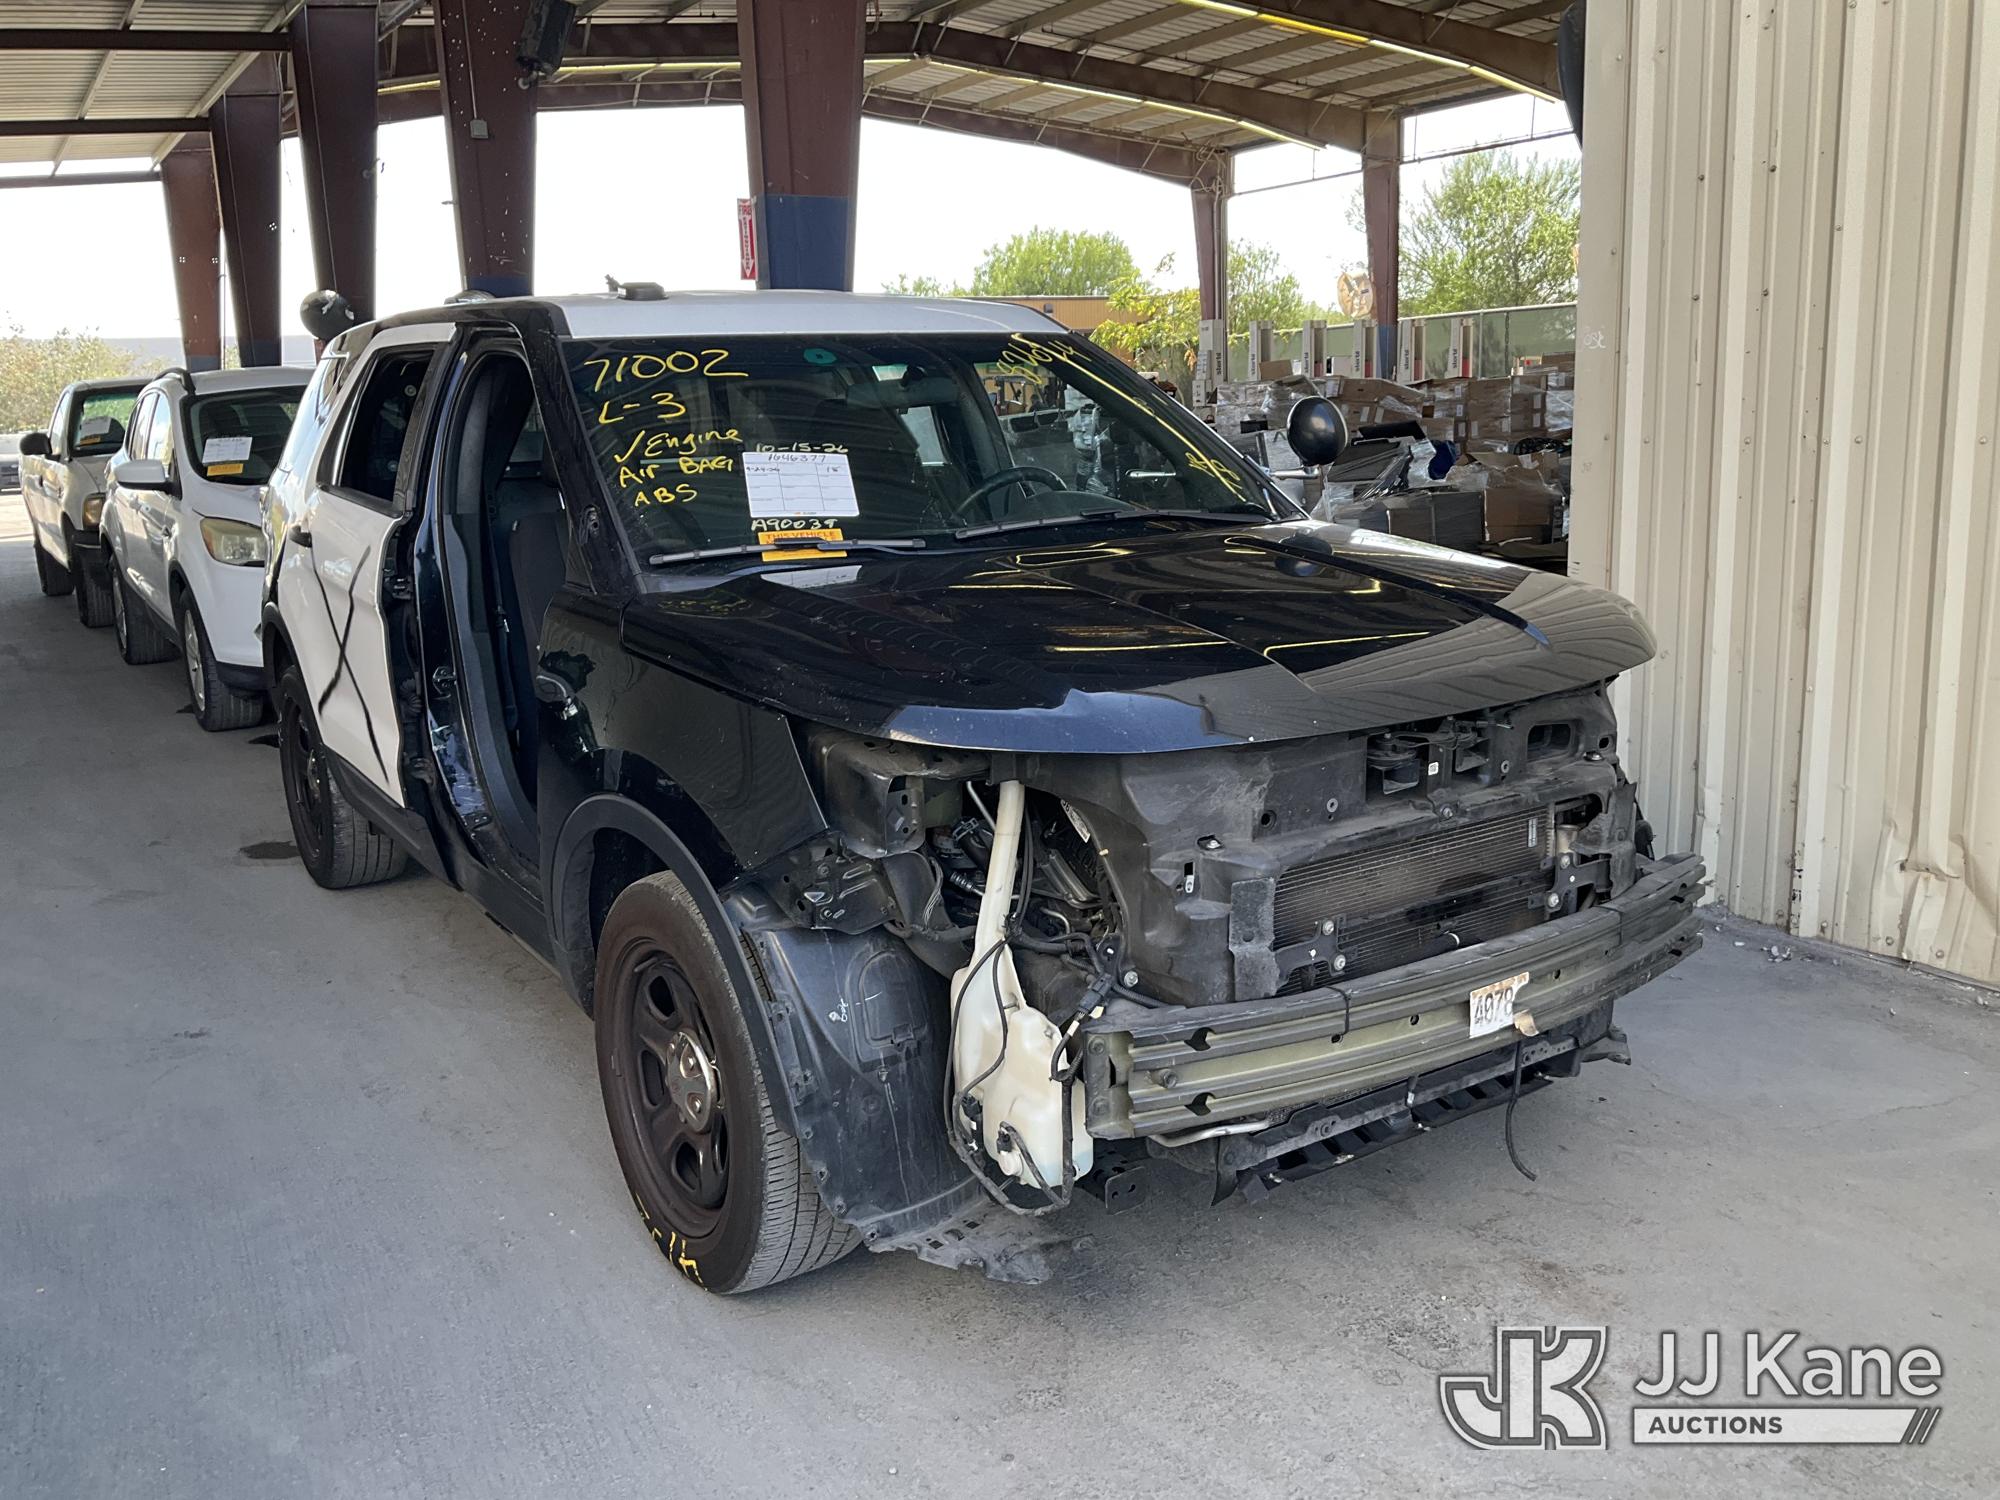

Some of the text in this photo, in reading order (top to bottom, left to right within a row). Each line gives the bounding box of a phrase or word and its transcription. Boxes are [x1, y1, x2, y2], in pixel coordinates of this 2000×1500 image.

[583, 349, 749, 392] 71002
[643, 427, 744, 457] Engine
[619, 463, 660, 488] Air
[679, 455, 734, 474] BAG
[633, 483, 698, 507] ABS
